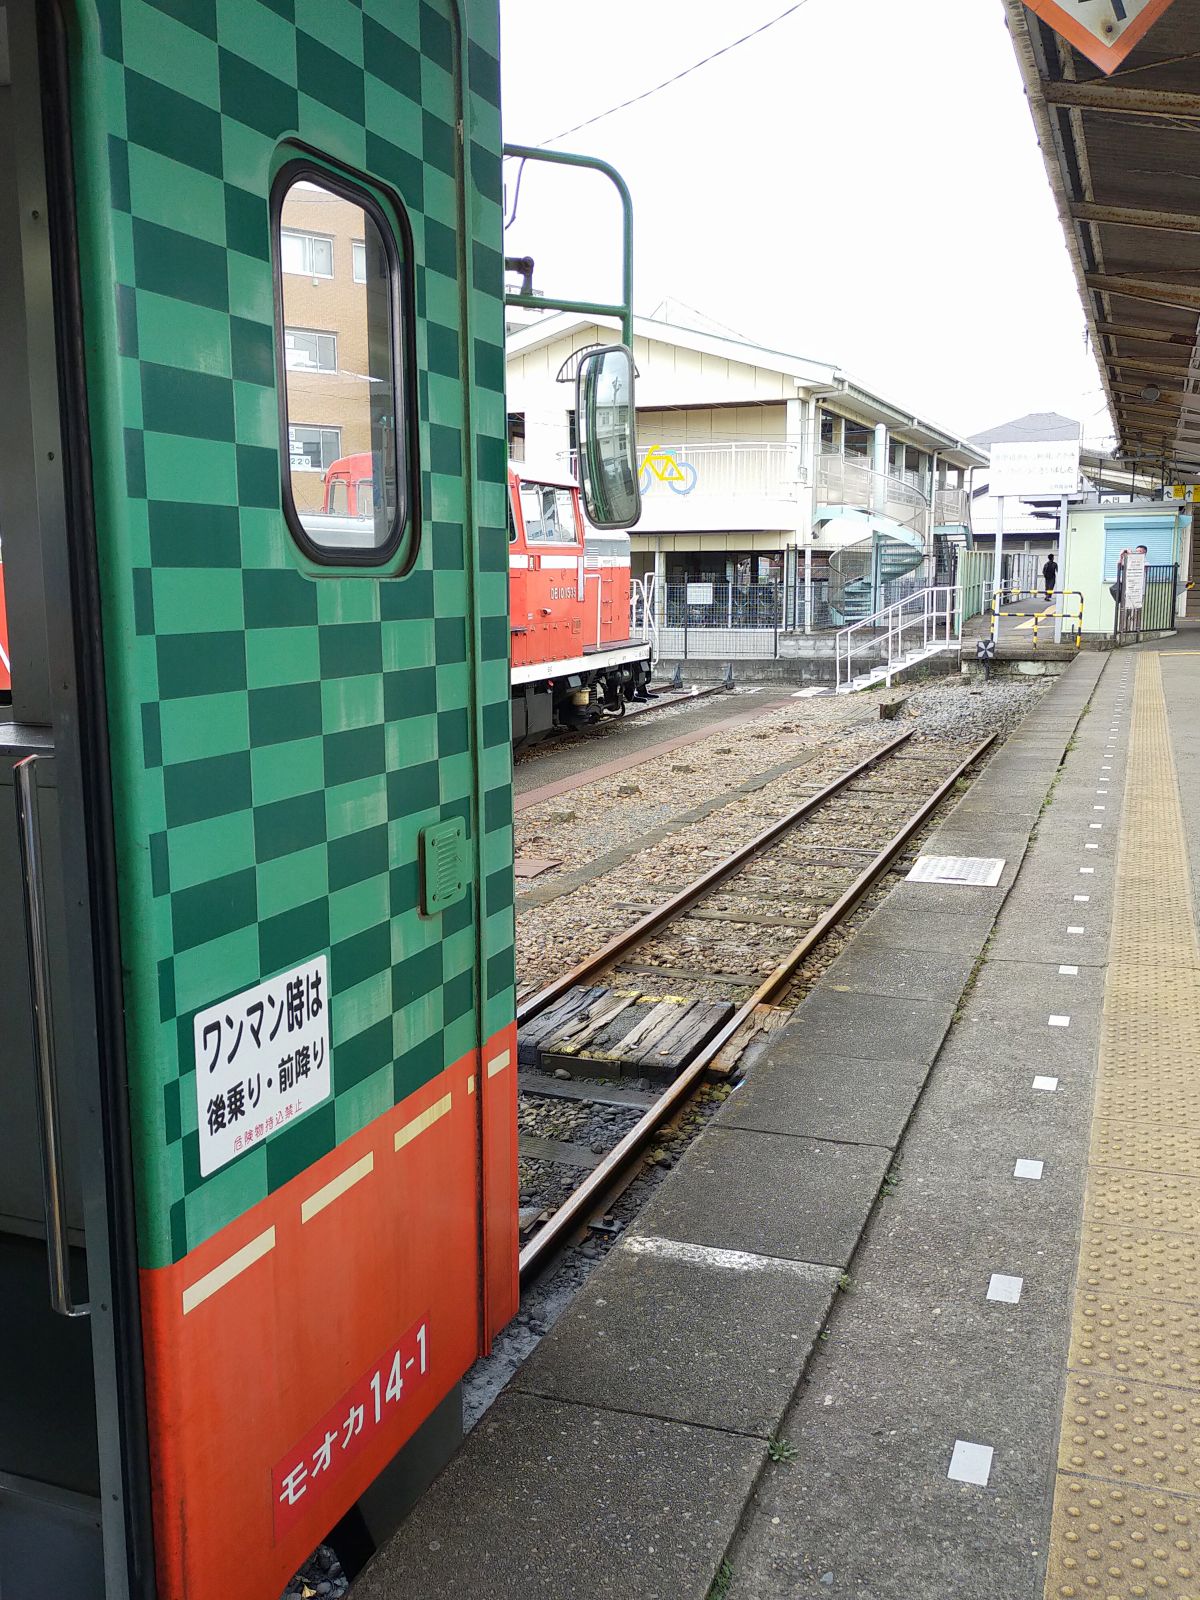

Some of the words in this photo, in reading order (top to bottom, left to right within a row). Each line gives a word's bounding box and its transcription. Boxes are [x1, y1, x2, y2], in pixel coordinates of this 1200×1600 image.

[203, 969, 323, 1074] ワンマン時は
[207, 1036, 325, 1137] 後乗り・前降り
[233, 1098, 303, 1153] 危険物持込禁止
